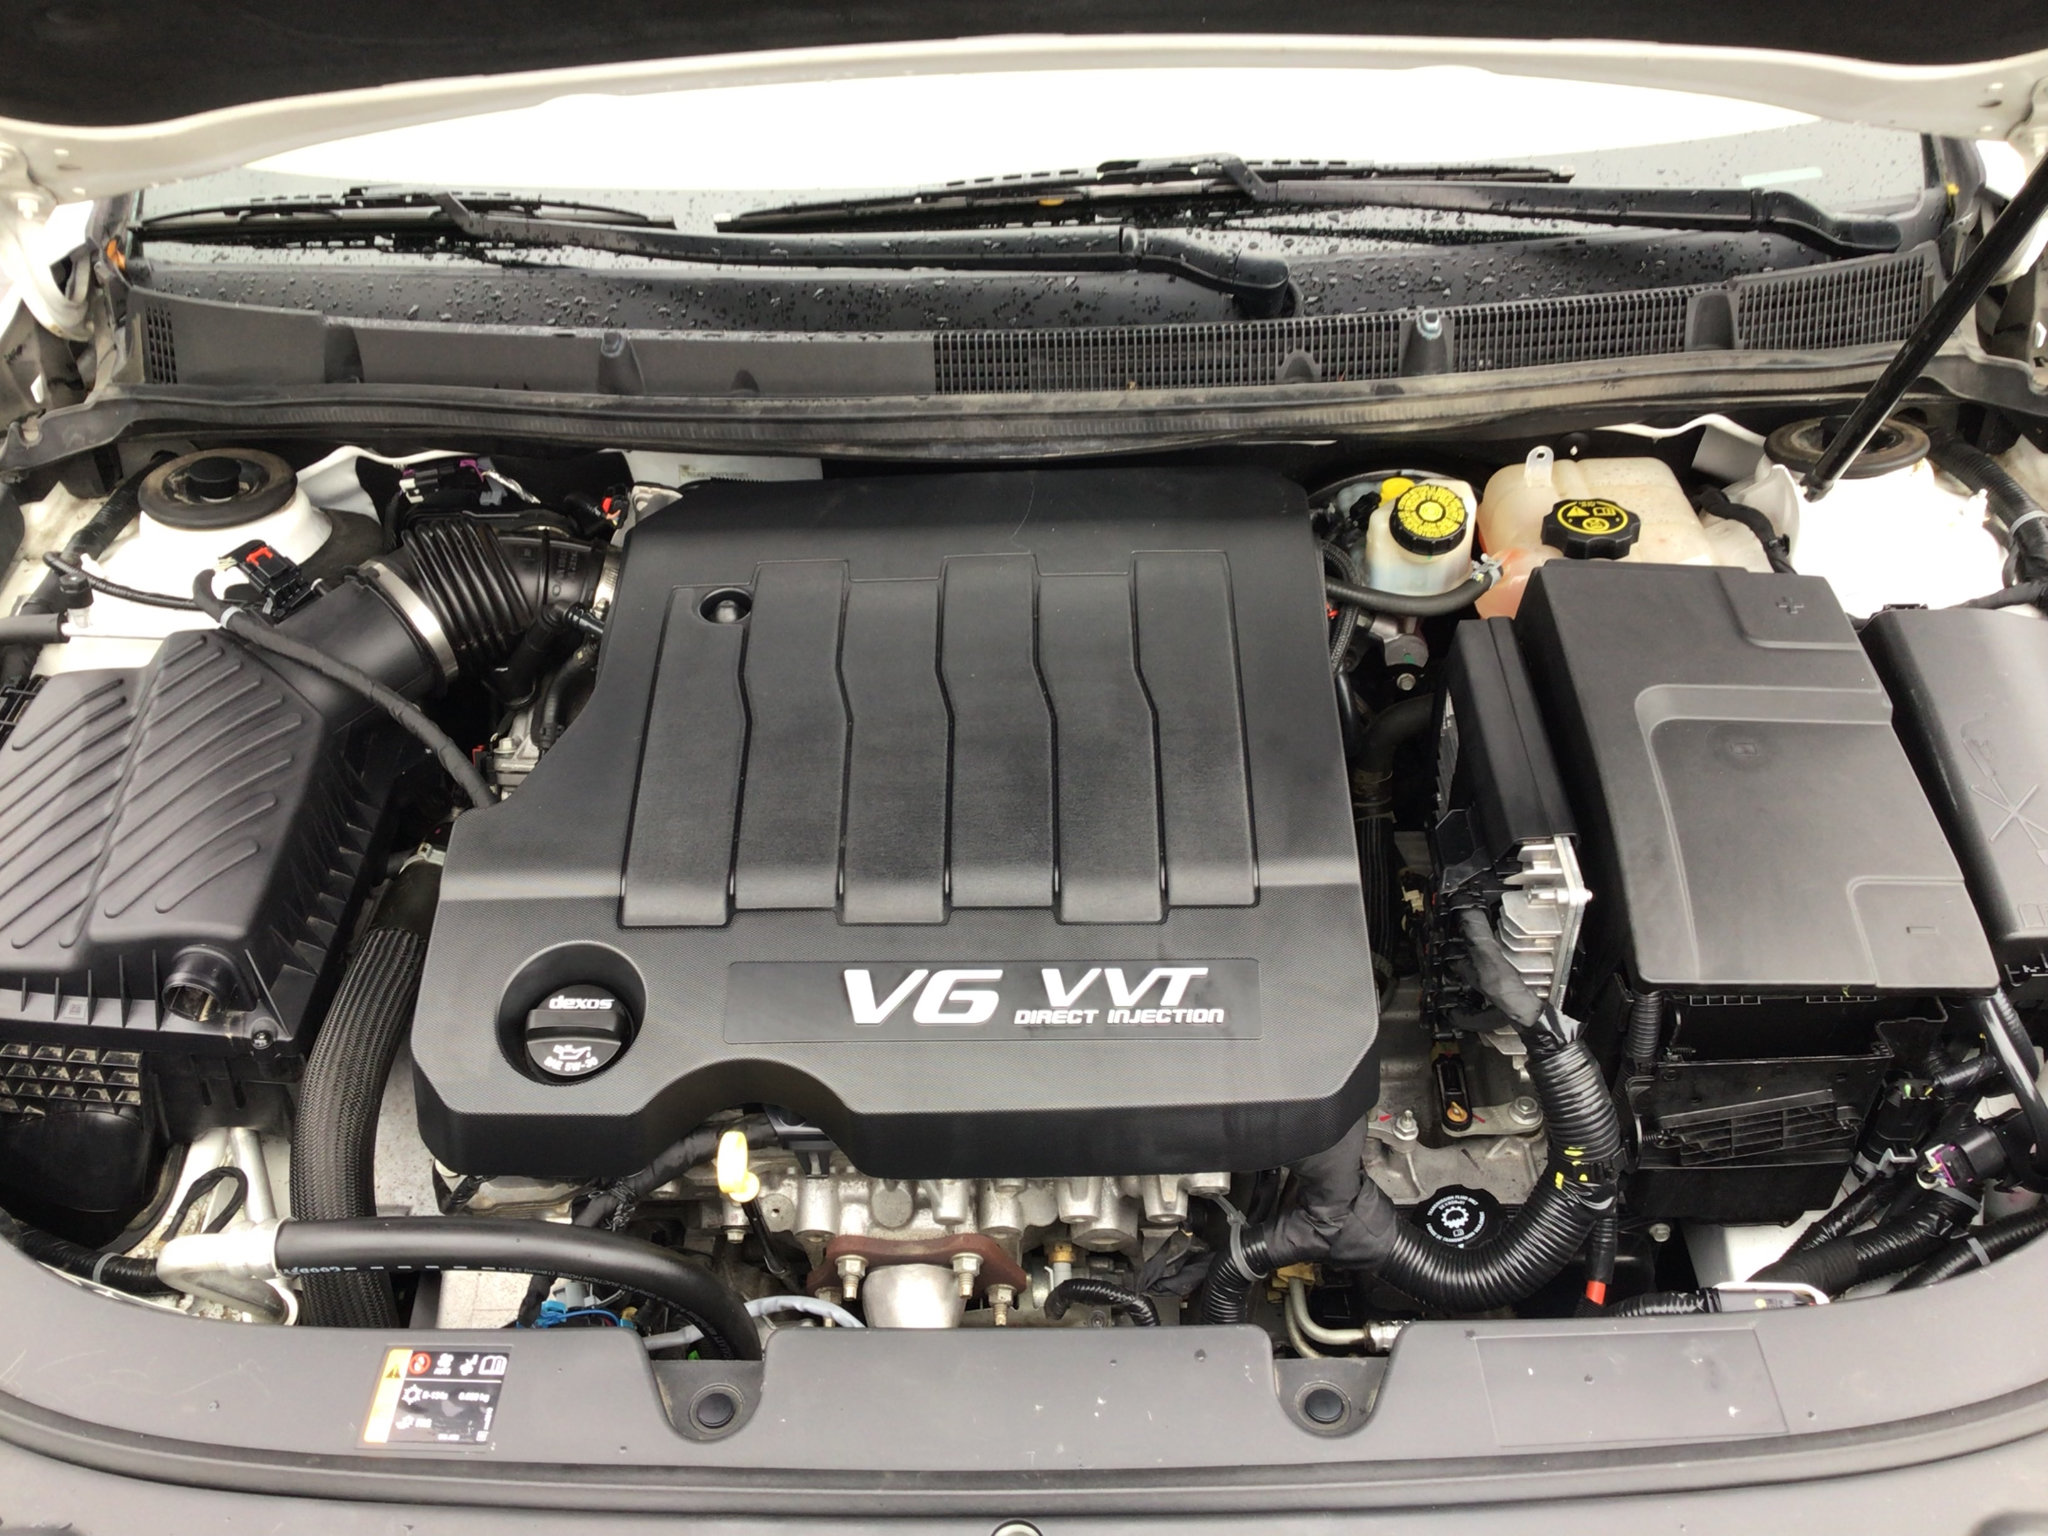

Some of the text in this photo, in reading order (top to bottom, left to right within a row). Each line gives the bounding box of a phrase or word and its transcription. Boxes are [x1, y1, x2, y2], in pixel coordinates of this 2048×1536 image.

[549, 994, 615, 1009] dexos
[843, 967, 1209, 1025] V6 VVT
[1014, 1008, 1225, 1025] DIRECT INJECTION
